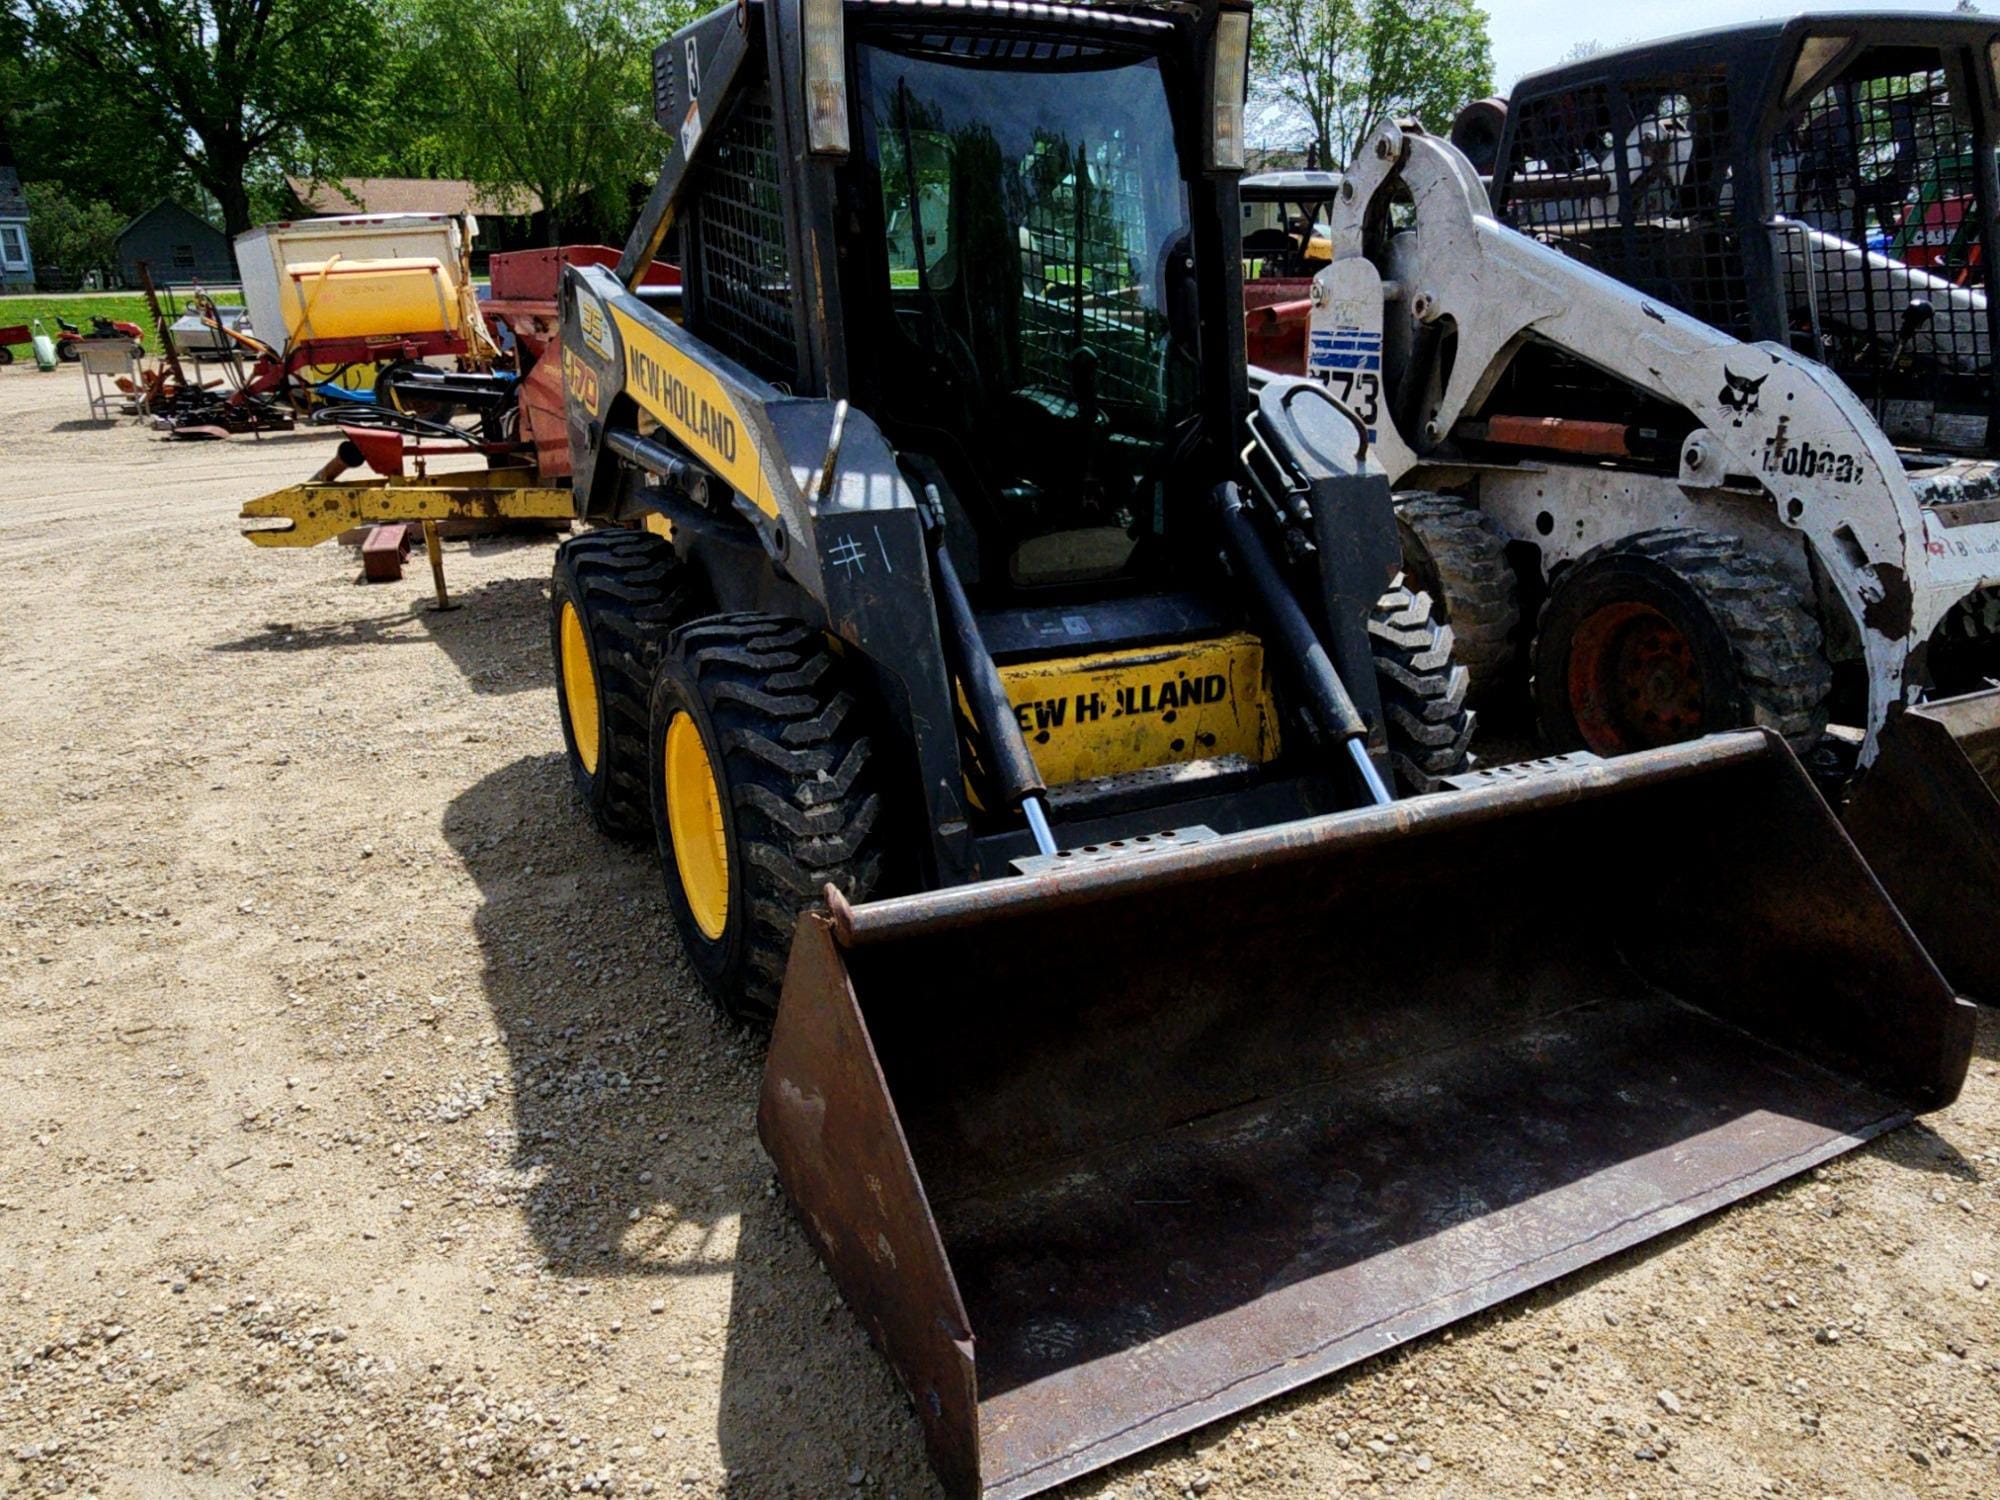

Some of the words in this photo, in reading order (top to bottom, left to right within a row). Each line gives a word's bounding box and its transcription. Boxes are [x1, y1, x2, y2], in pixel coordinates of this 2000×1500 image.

[629, 344, 661, 400] NEW
[663, 375, 736, 464] HOLLAND
[1012, 696, 1067, 732] EW
